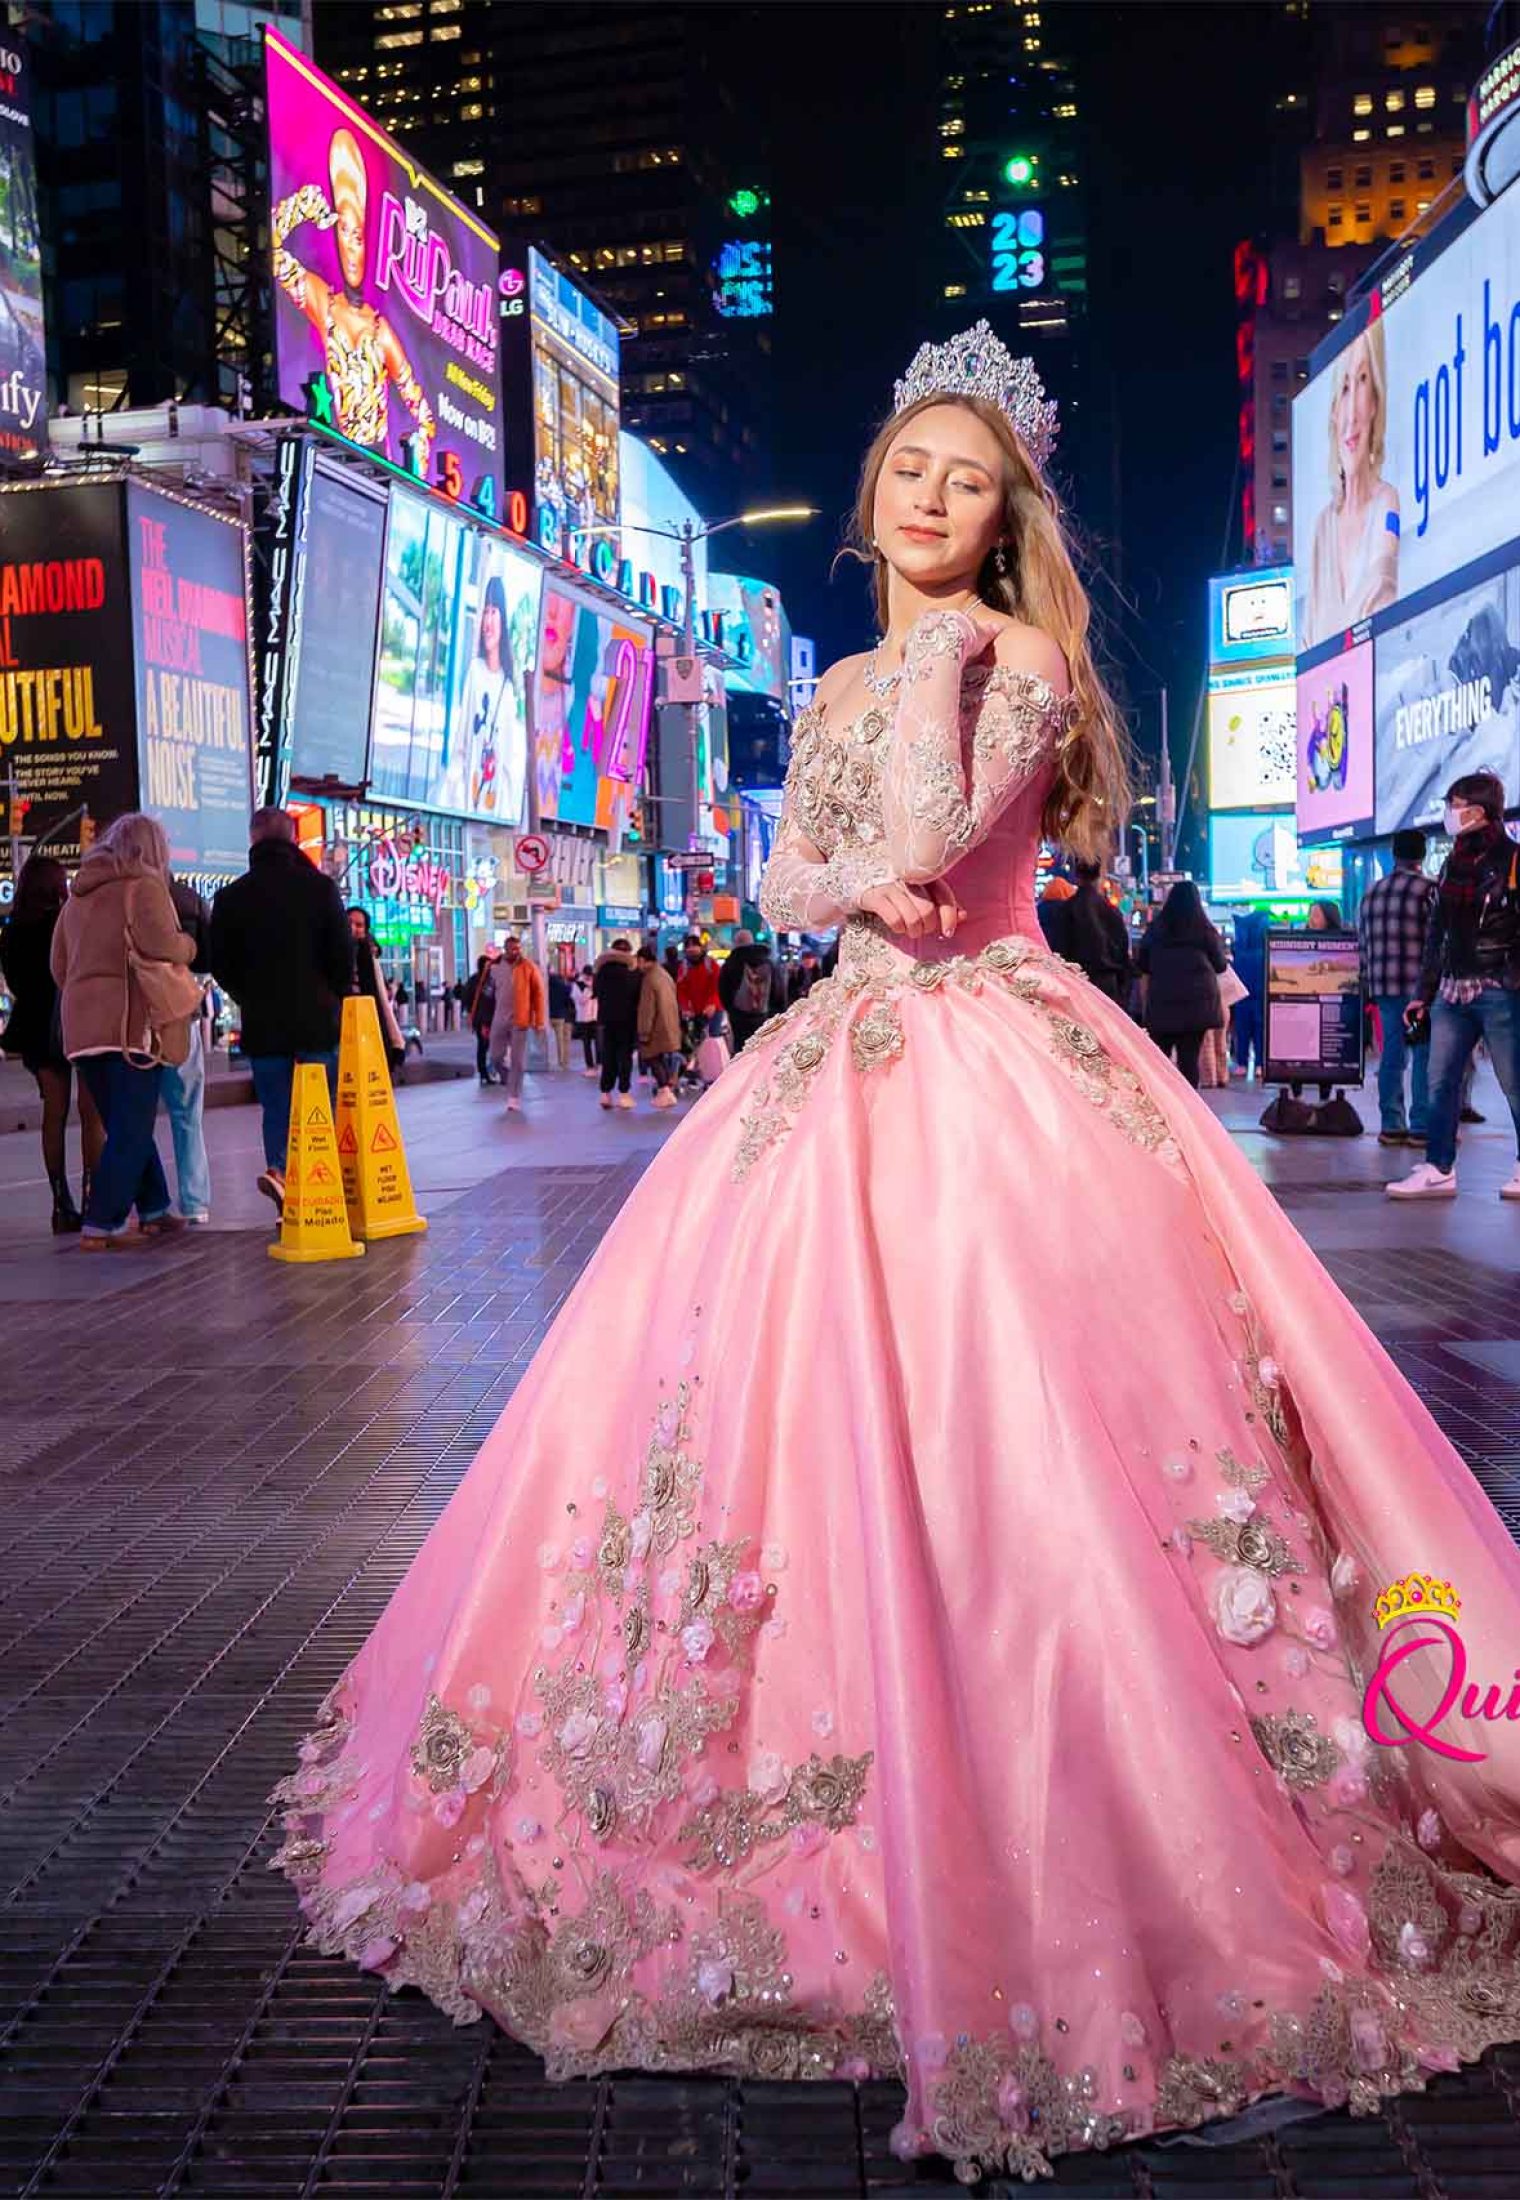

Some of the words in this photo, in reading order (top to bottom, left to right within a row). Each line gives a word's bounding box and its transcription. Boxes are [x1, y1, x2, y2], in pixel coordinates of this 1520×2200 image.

[991, 210, 1043, 251] 20
[991, 251, 1045, 291] 23
[501, 299, 523, 316] LG
[1414, 314, 1465, 537] got
[160, 671, 245, 752] BEAUTIFUL
[147, 737, 198, 811] NOISE
